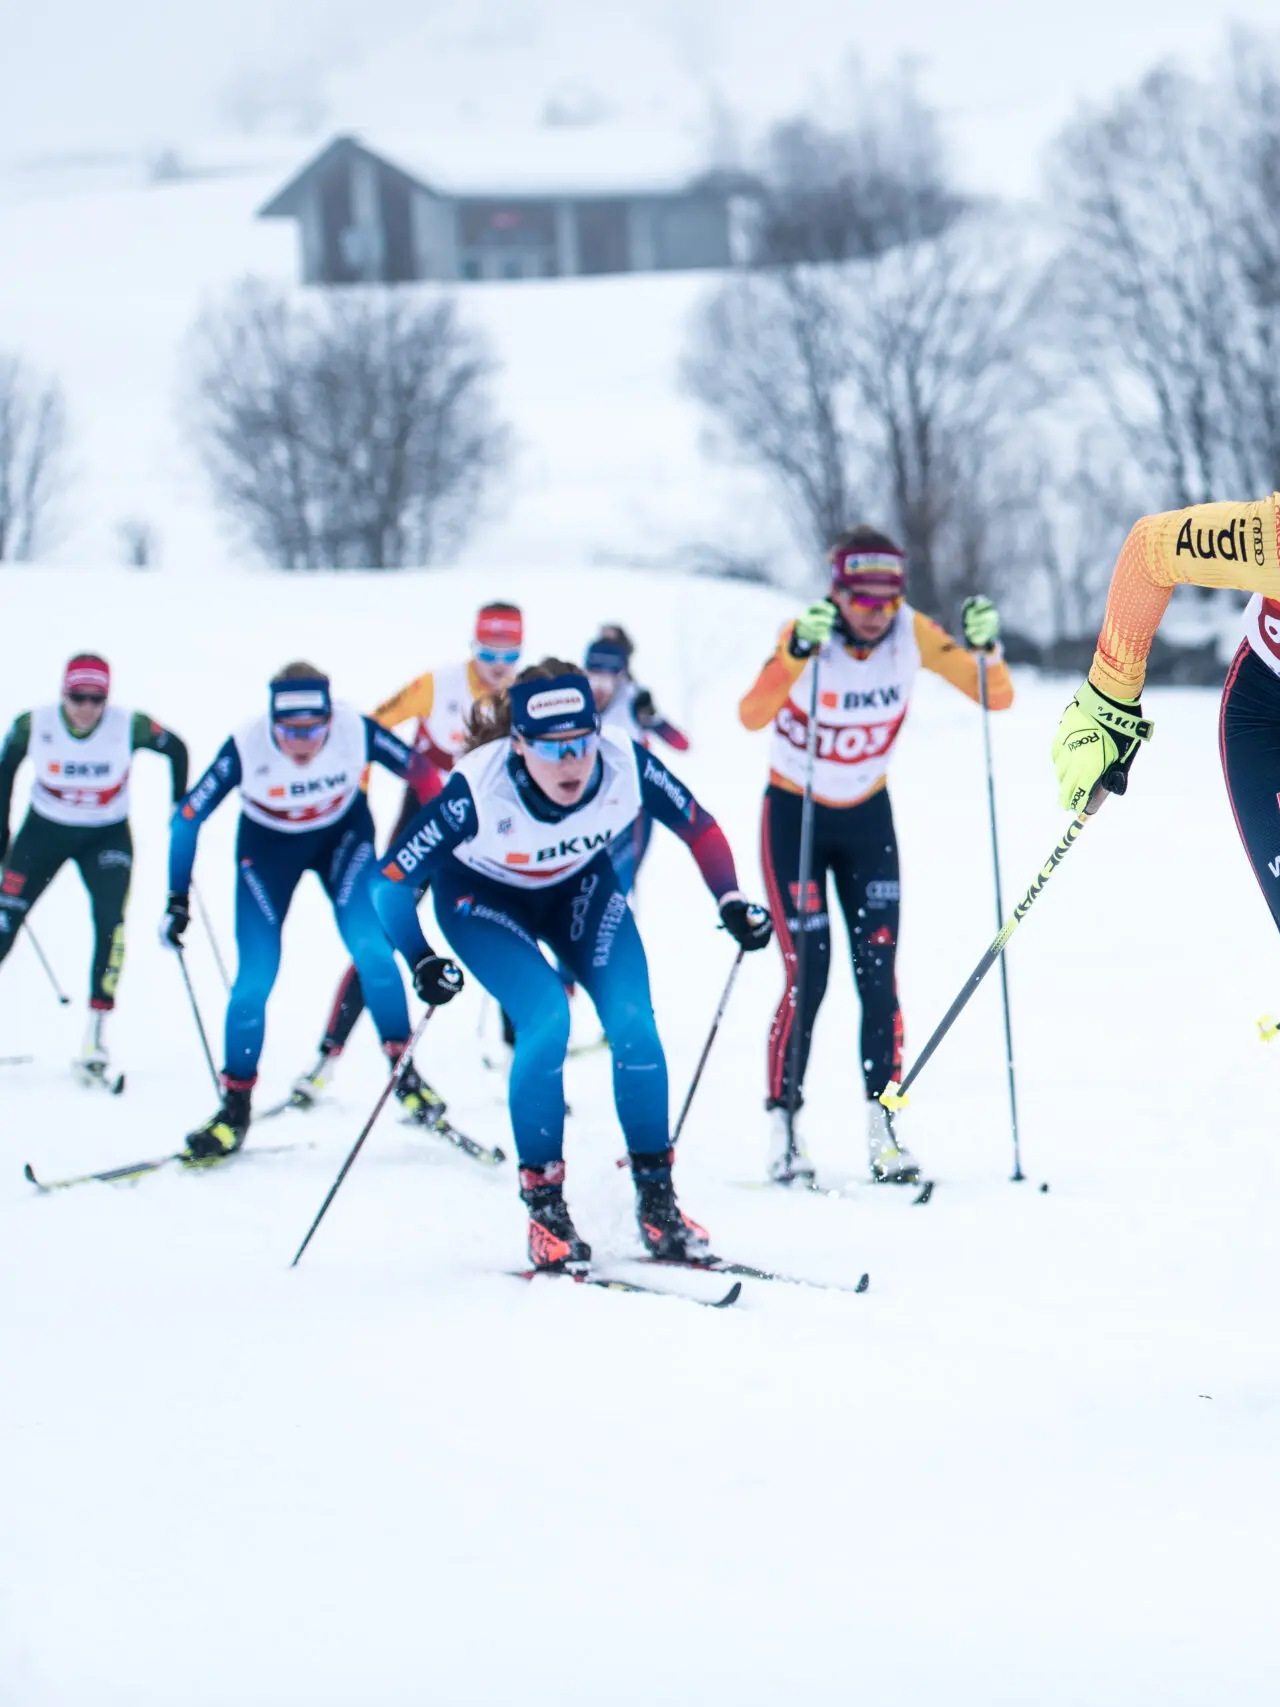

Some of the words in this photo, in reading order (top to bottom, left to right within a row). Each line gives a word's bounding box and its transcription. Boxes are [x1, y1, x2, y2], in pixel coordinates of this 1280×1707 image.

[1175, 518, 1248, 562] Audi
[844, 686, 900, 710] BKW
[395, 818, 444, 873] BKW
[535, 829, 613, 862] BKW
